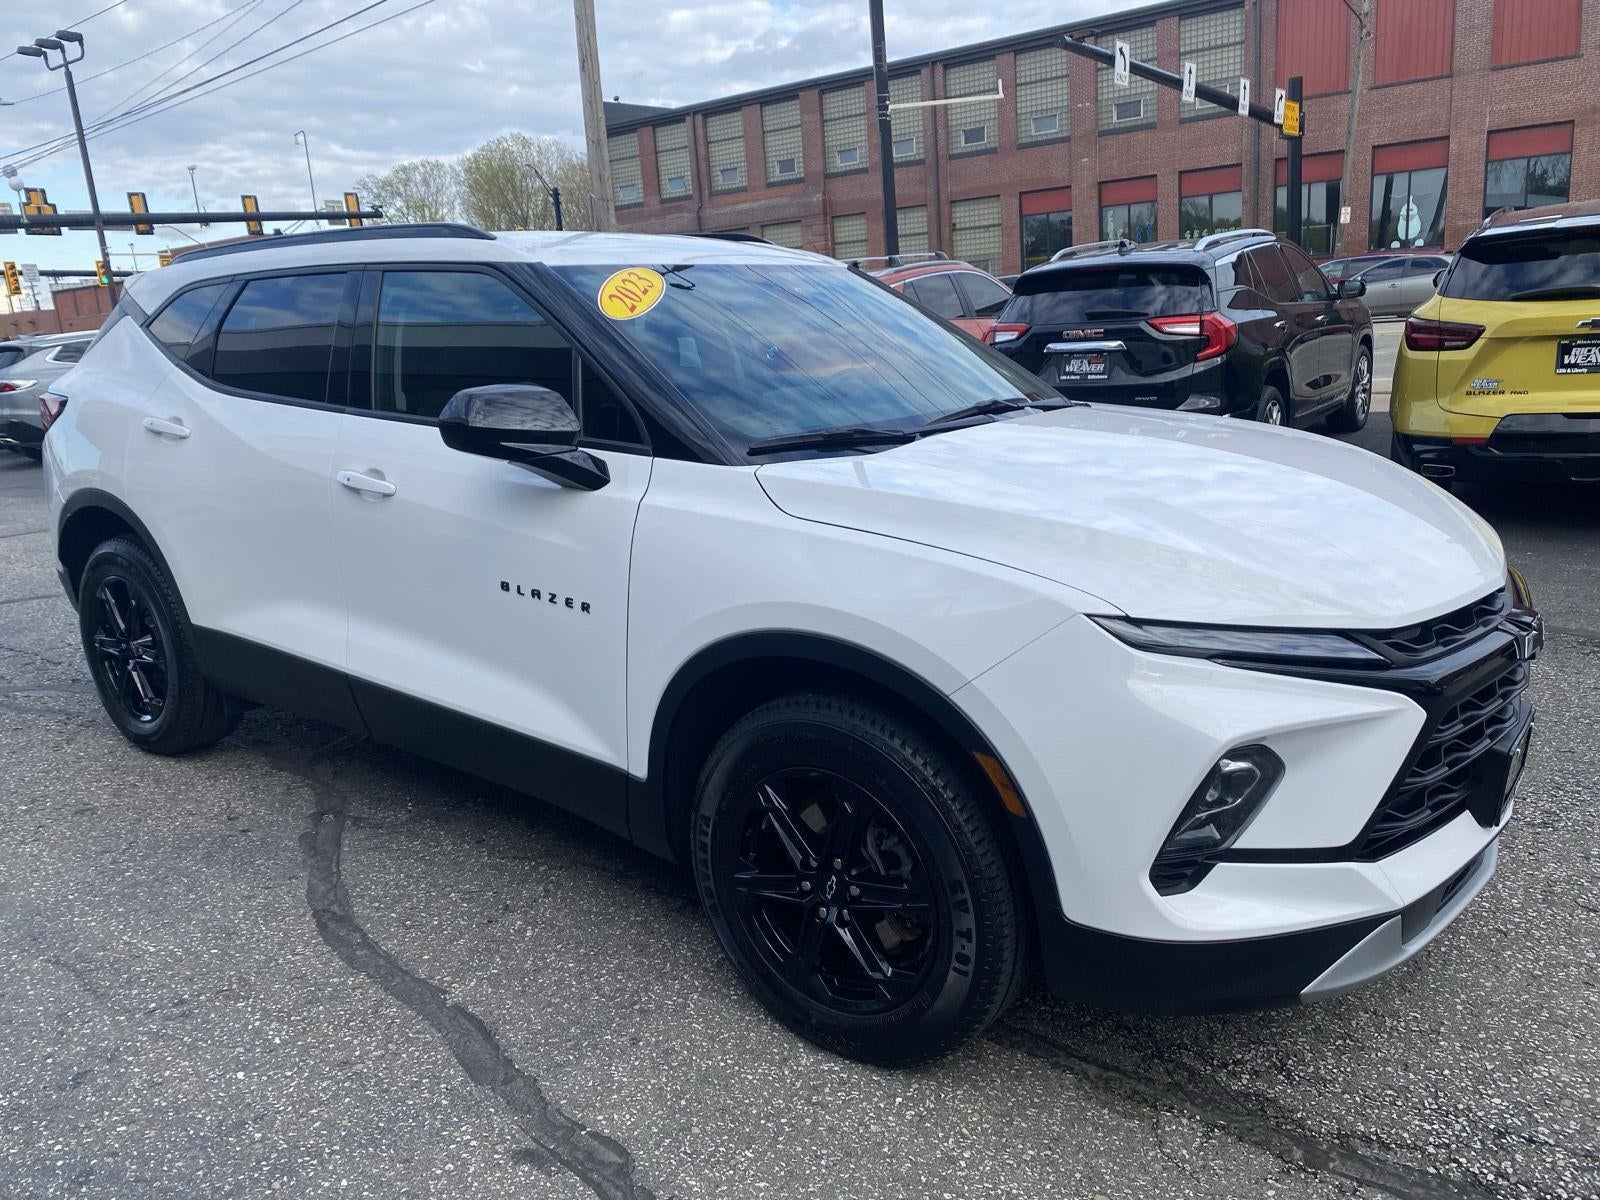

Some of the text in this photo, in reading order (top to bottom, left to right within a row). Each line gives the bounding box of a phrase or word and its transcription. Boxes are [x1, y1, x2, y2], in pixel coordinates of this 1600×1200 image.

[608, 271, 654, 313] 2023
[1062, 328, 1104, 339] GMC
[1065, 363, 1104, 373] WEAVER
[500, 580, 591, 614] BLAZER
